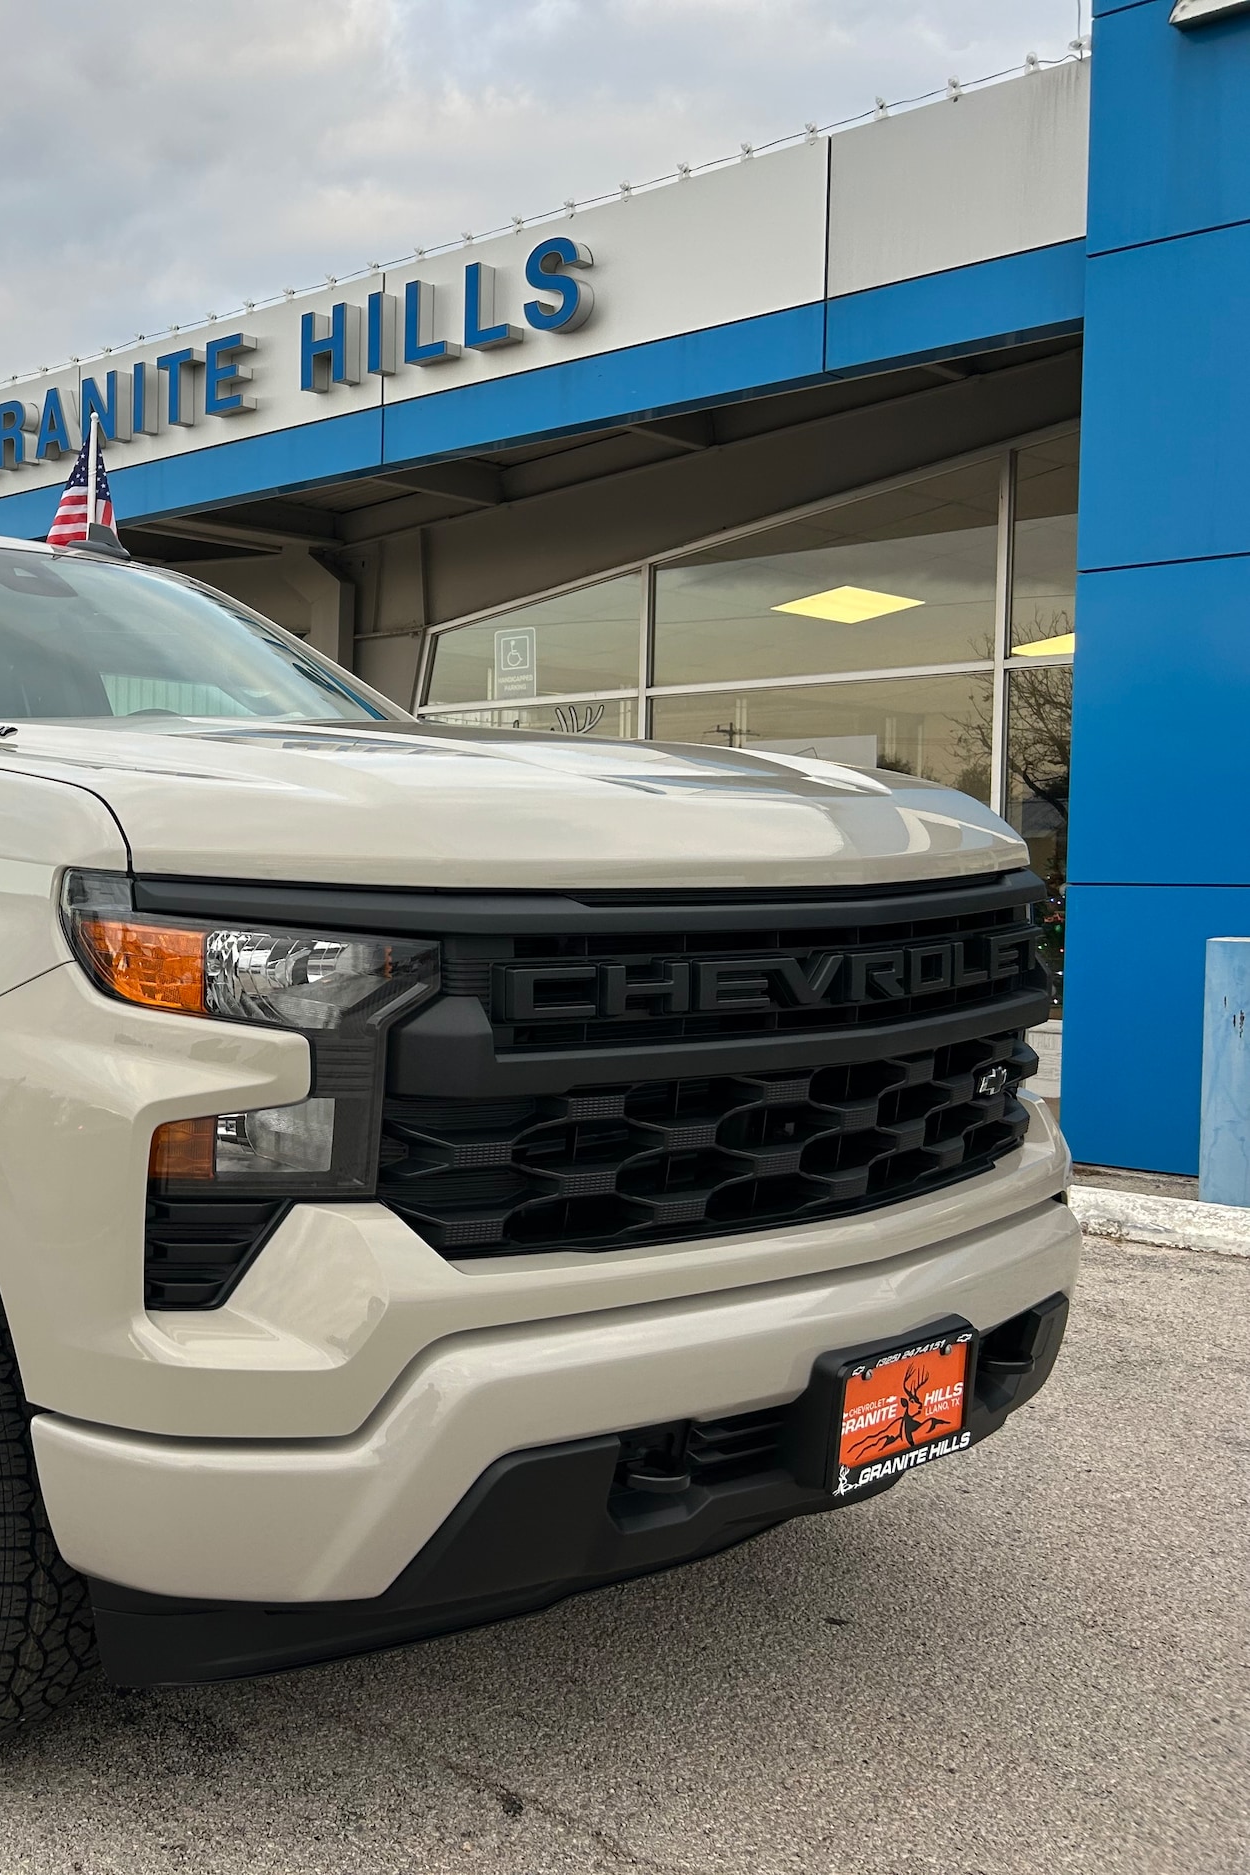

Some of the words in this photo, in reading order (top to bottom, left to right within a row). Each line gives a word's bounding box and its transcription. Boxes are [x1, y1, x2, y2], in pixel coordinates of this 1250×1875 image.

[301, 237, 594, 393] HILLS
[498, 674, 533, 683] HANDICAPPED
[495, 927, 1043, 1022] CHEVROLET
[876, 1353, 901, 1368] (325)
[924, 1382, 963, 1406] HILLS
[849, 1398, 886, 1417] CHEVROLET
[925, 1401, 949, 1416] LLANO,
[951, 1398, 961, 1408] TX
[859, 1446, 928, 1484] GRANITE
[929, 1431, 970, 1459] HILLS
